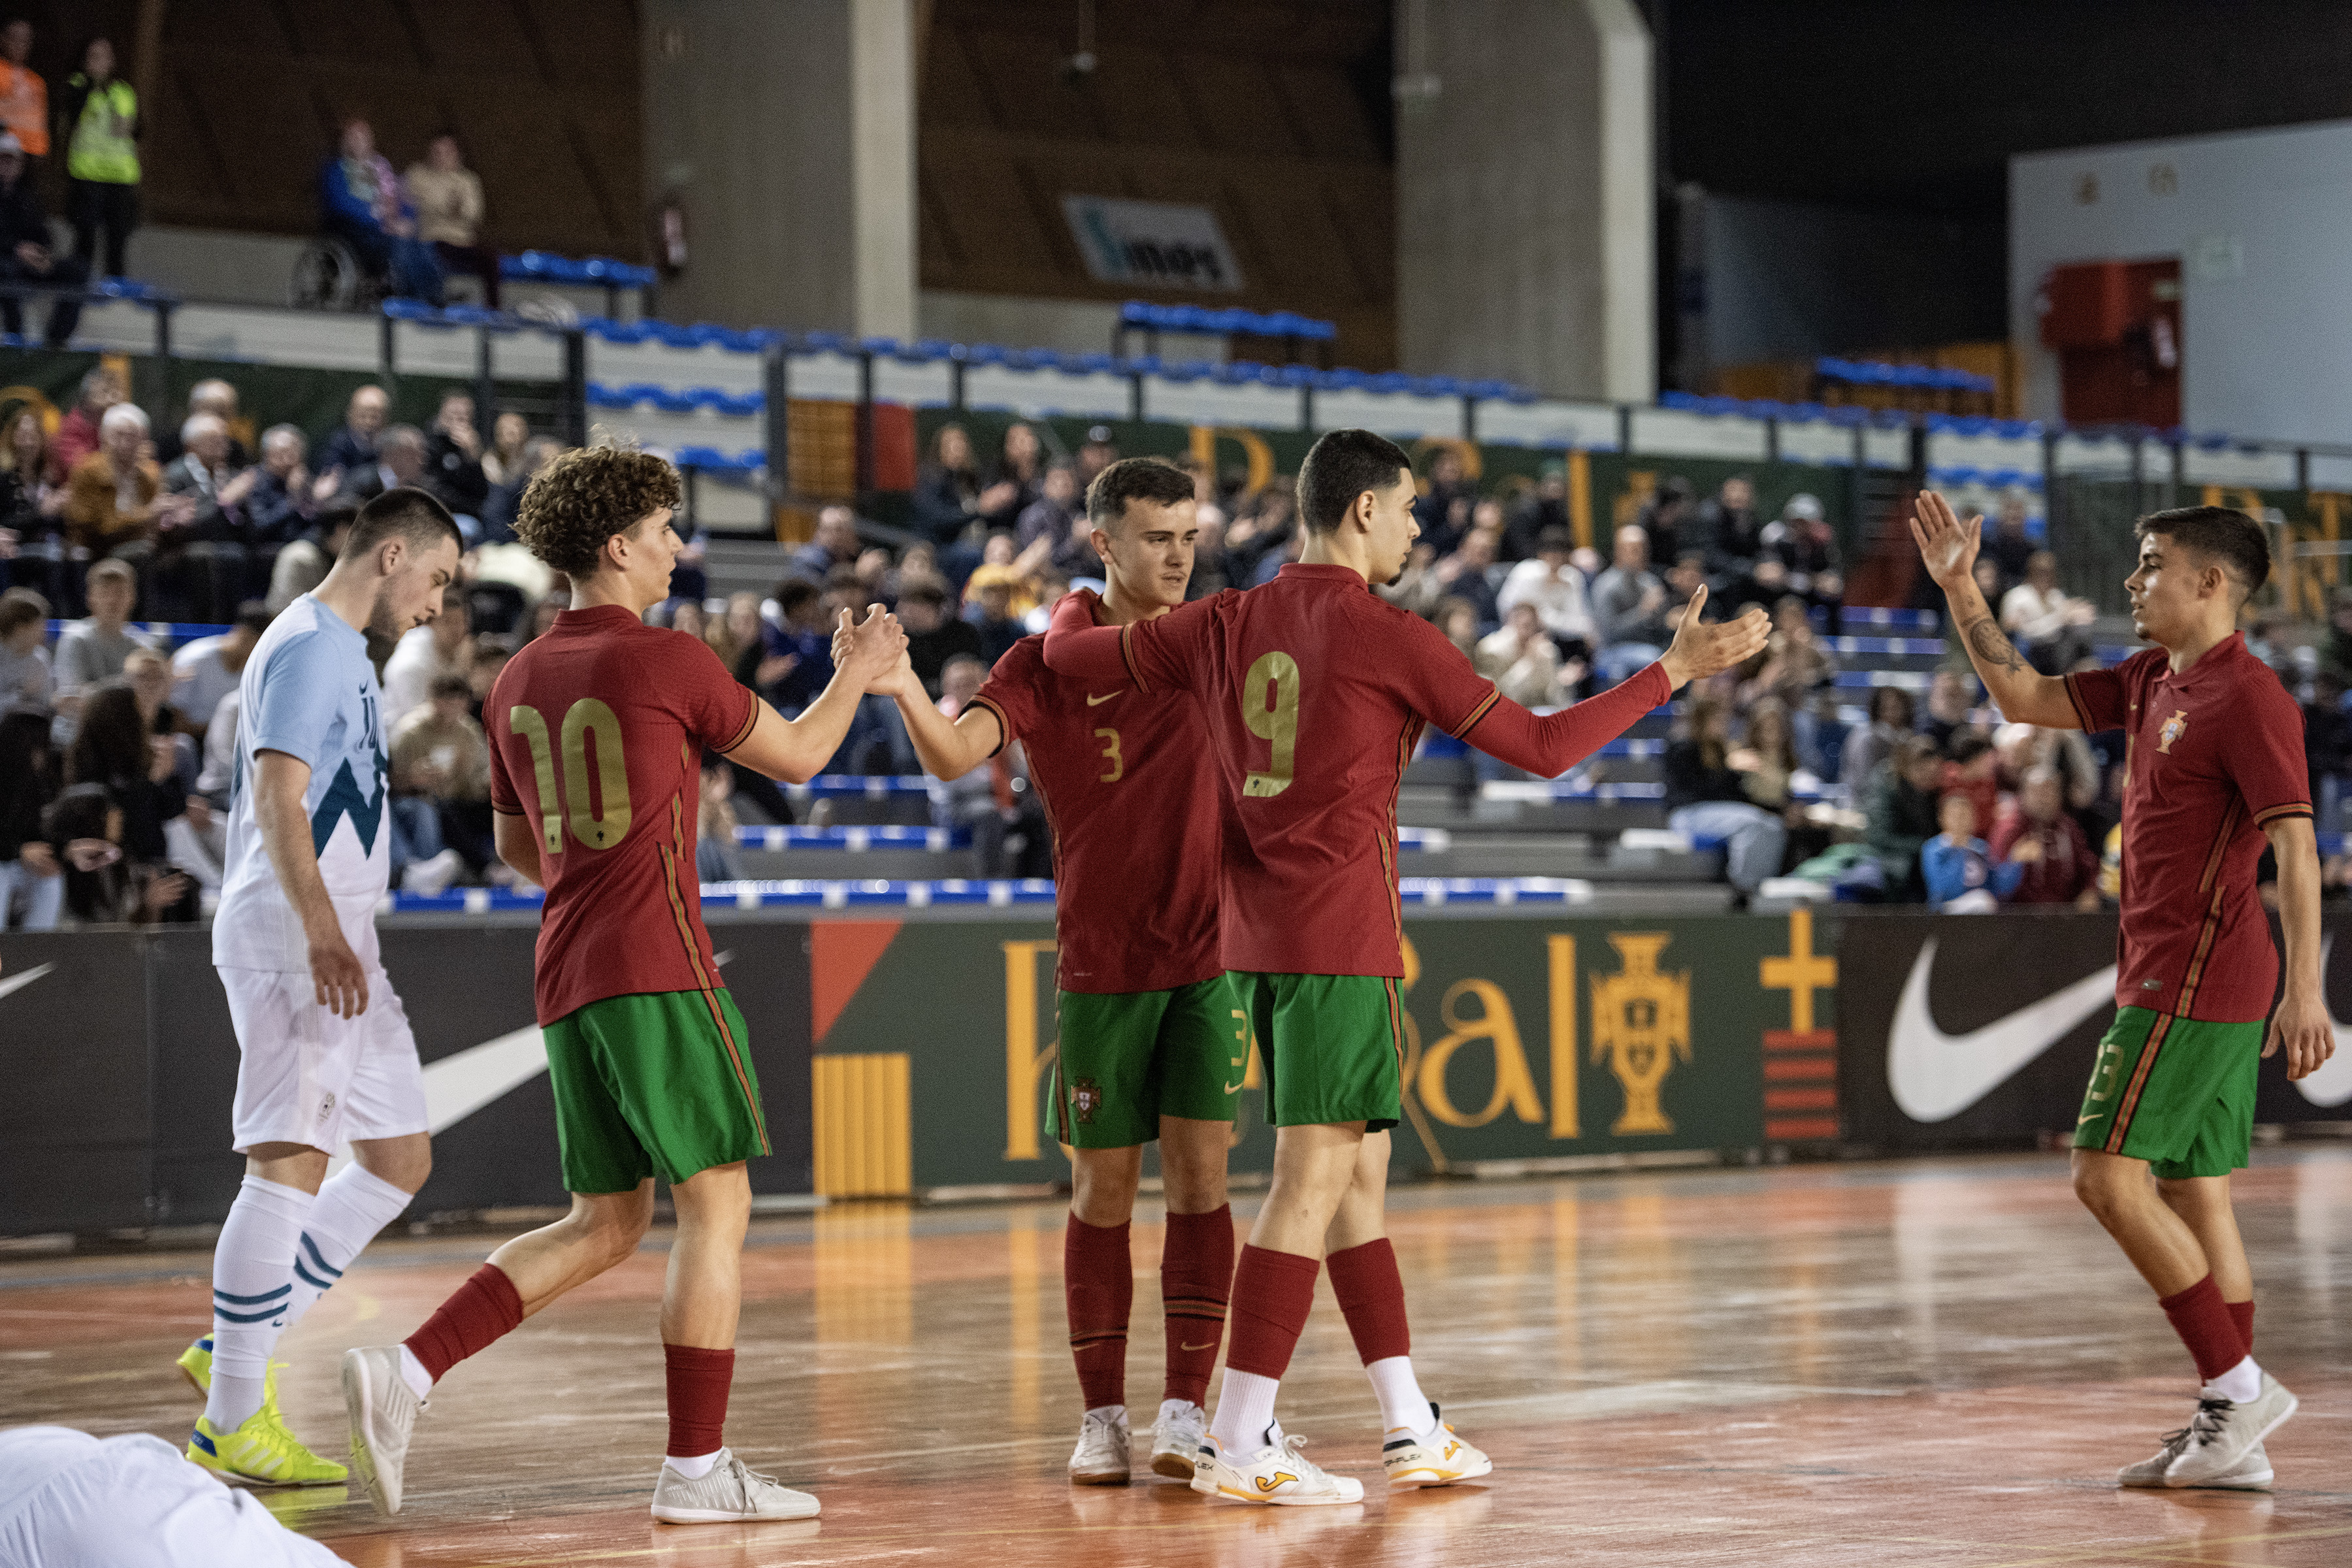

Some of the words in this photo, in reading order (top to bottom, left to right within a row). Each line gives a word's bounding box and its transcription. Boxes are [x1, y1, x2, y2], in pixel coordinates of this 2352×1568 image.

[510, 697, 632, 854] 10
[1094, 728, 1123, 782] 3
[1242, 651, 1299, 798] 9
[1231, 1009, 1247, 1067] 3
